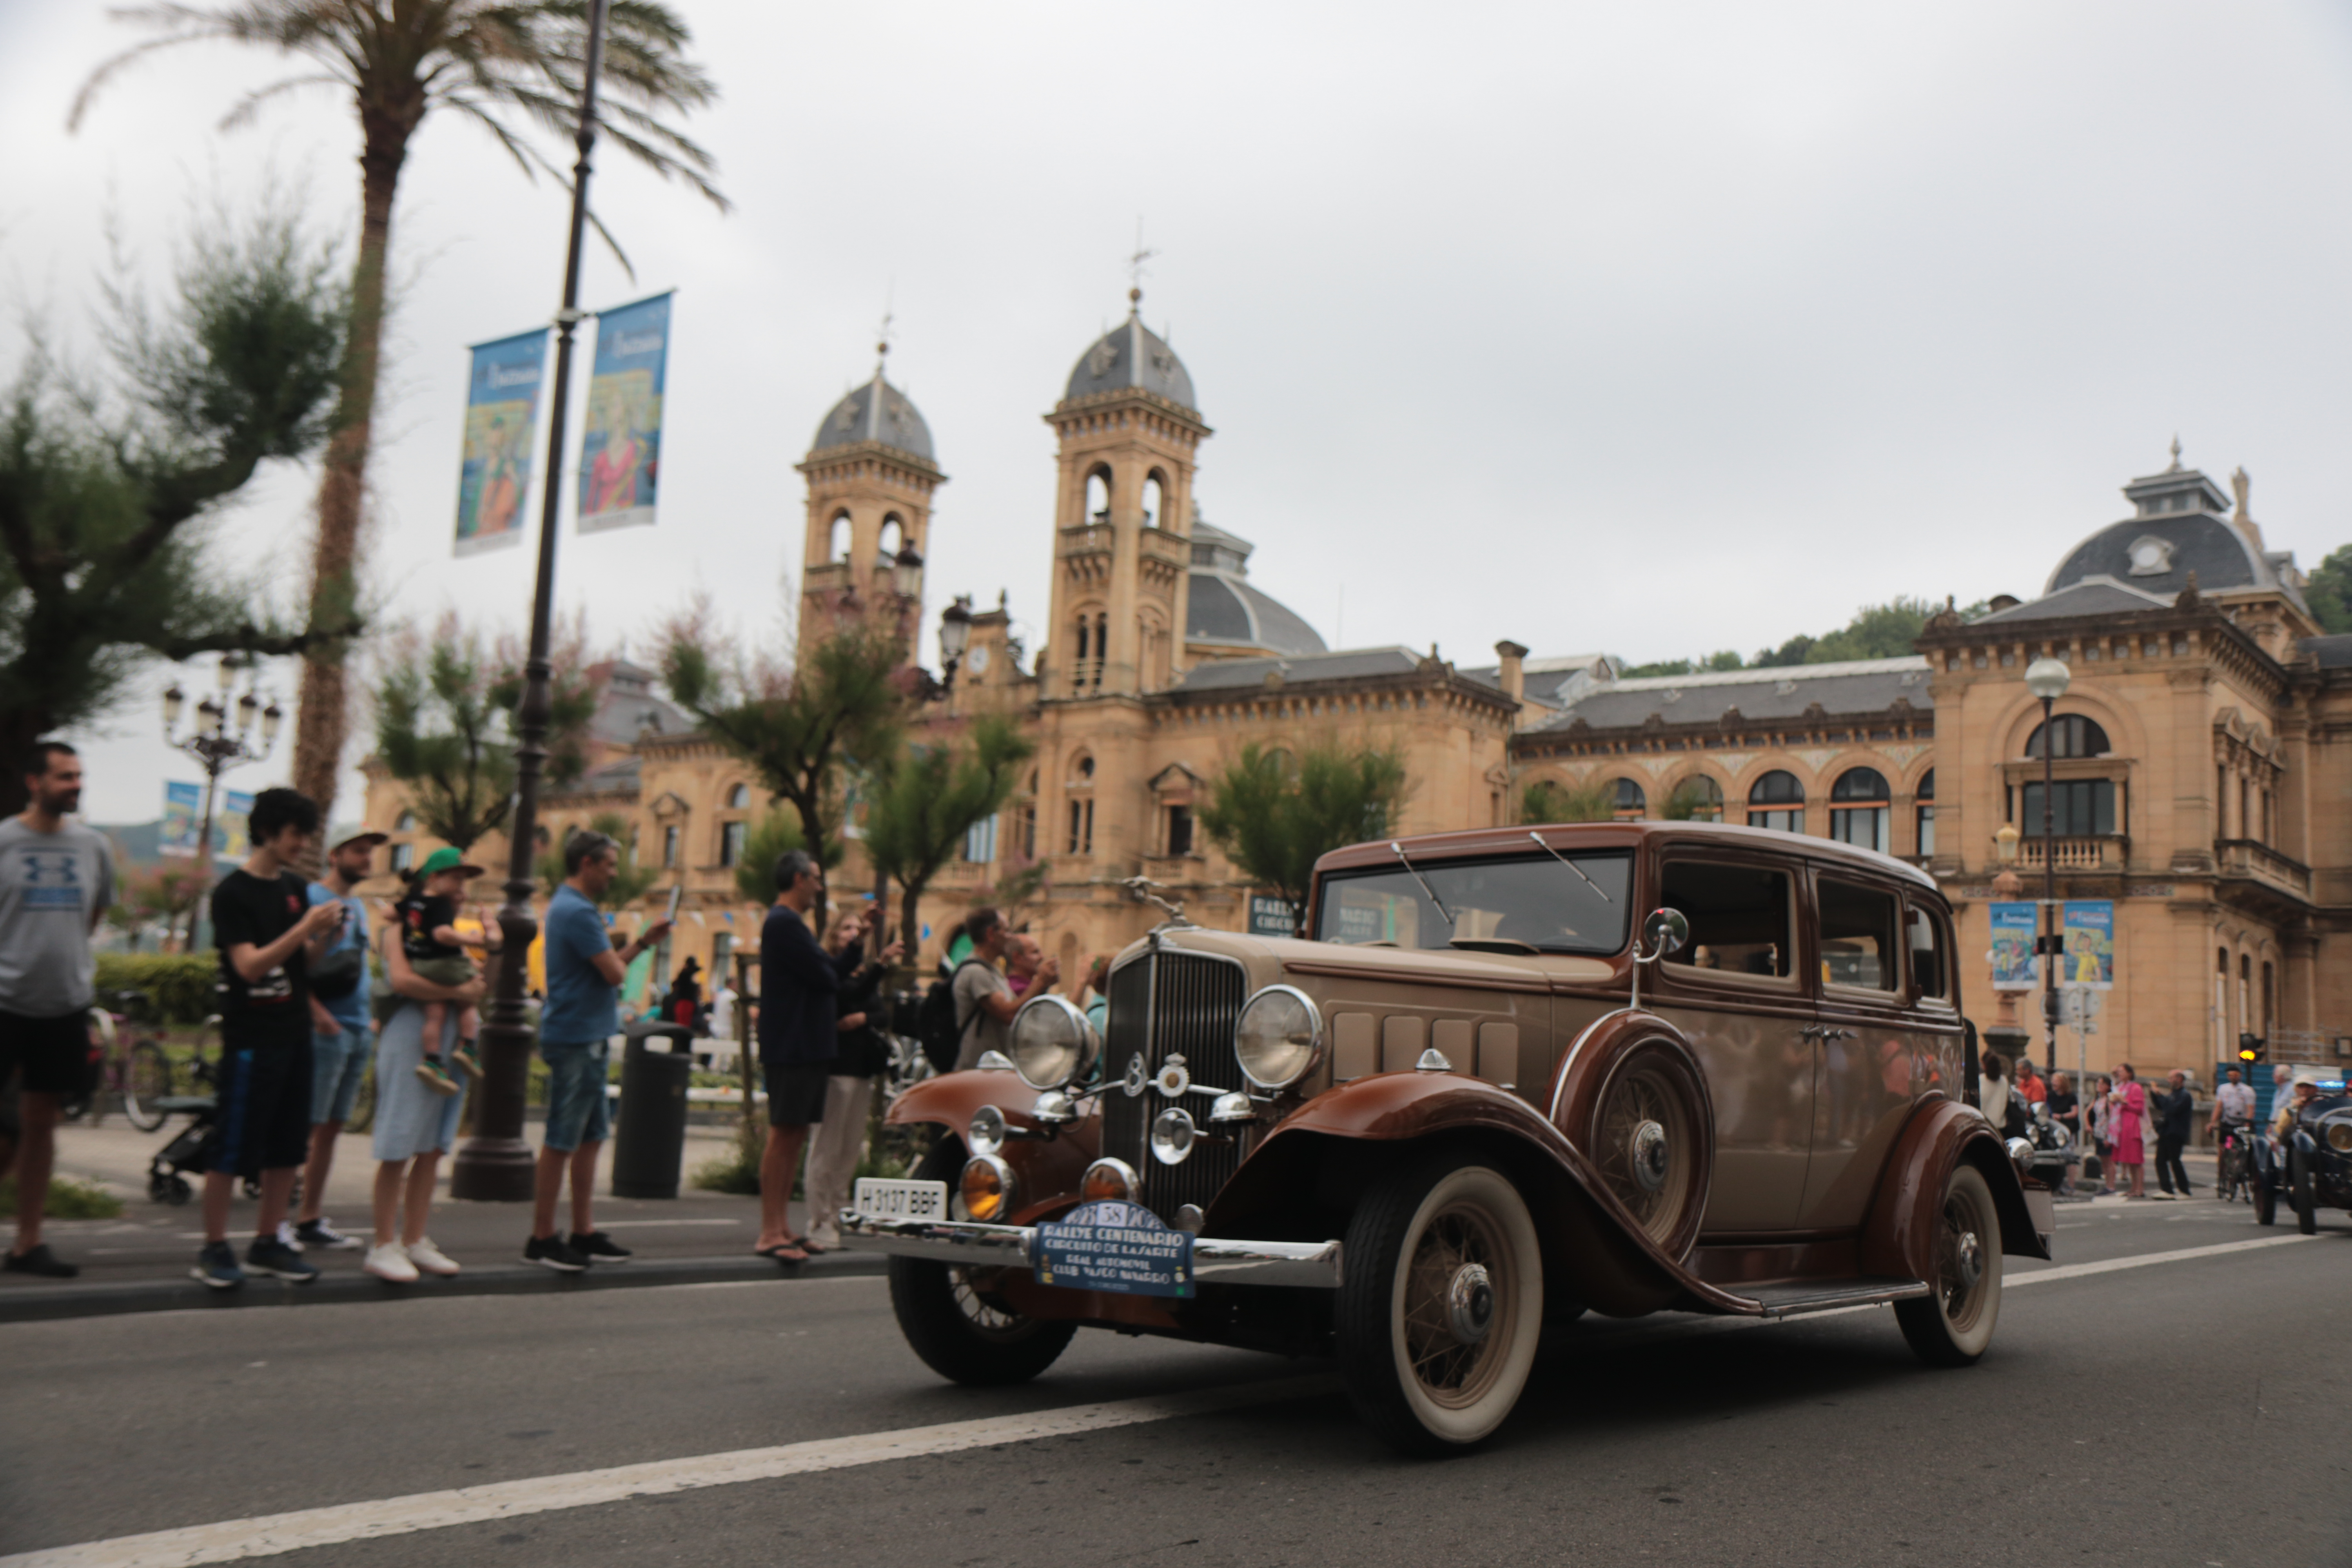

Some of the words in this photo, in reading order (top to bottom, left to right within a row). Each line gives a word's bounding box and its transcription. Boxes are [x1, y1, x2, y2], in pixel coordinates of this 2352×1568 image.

[861, 1188, 872, 1211] H
[875, 1189, 906, 1212] 3137
[910, 1190, 939, 1214] BBF
[1043, 1225, 1093, 1240] RALLYE
[1096, 1227, 1184, 1247] CENTENARIO
[1044, 1238, 1102, 1252] CIRCUITO
[1104, 1242, 1119, 1254] DE
[1066, 1254, 1092, 1265] REAL
[1095, 1257, 1151, 1270] AUTOMOVIL
[1053, 1264, 1079, 1276] CLUB
[1083, 1266, 1116, 1278] VASCO
[1120, 1270, 1171, 1285] NAVARRO
